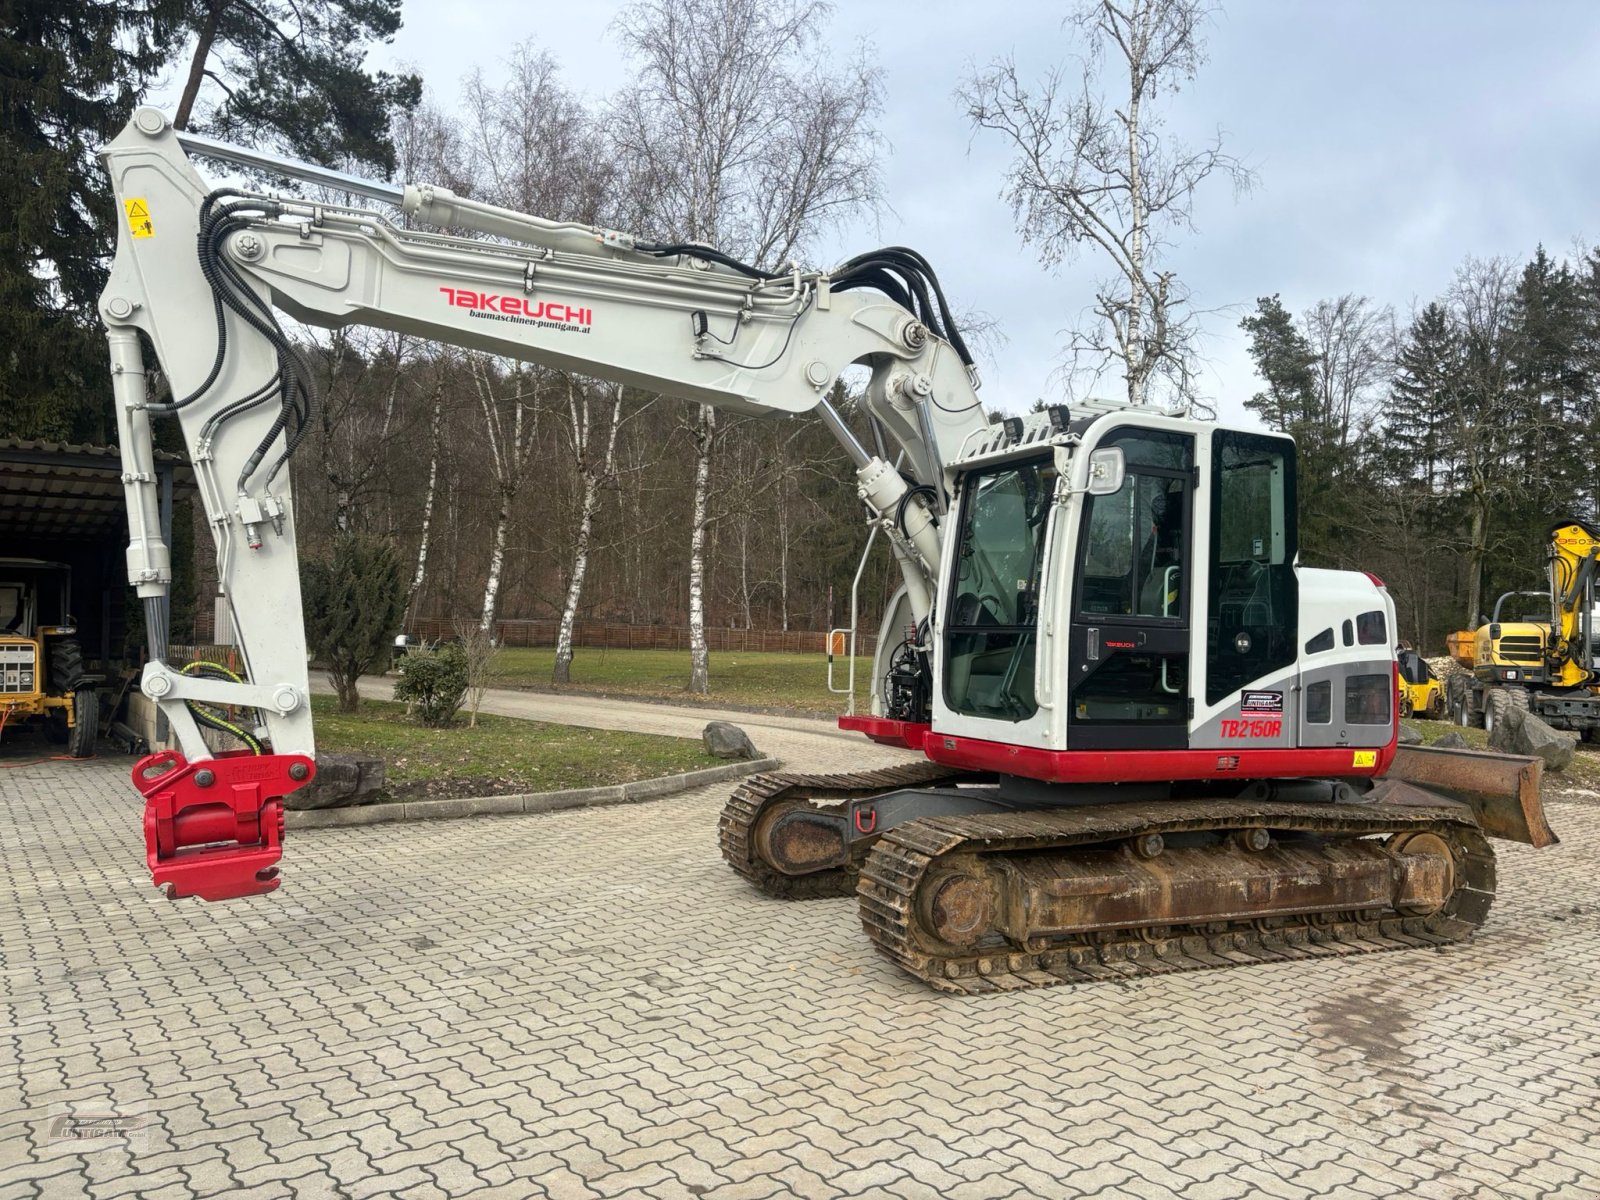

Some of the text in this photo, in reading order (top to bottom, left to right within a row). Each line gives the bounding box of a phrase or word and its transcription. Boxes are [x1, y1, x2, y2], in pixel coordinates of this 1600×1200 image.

[440, 287, 592, 325] TAKEUCHI
[469, 309, 591, 334] baumaschinen-puntigam.at
[1220, 720, 1282, 738] TB2150R
